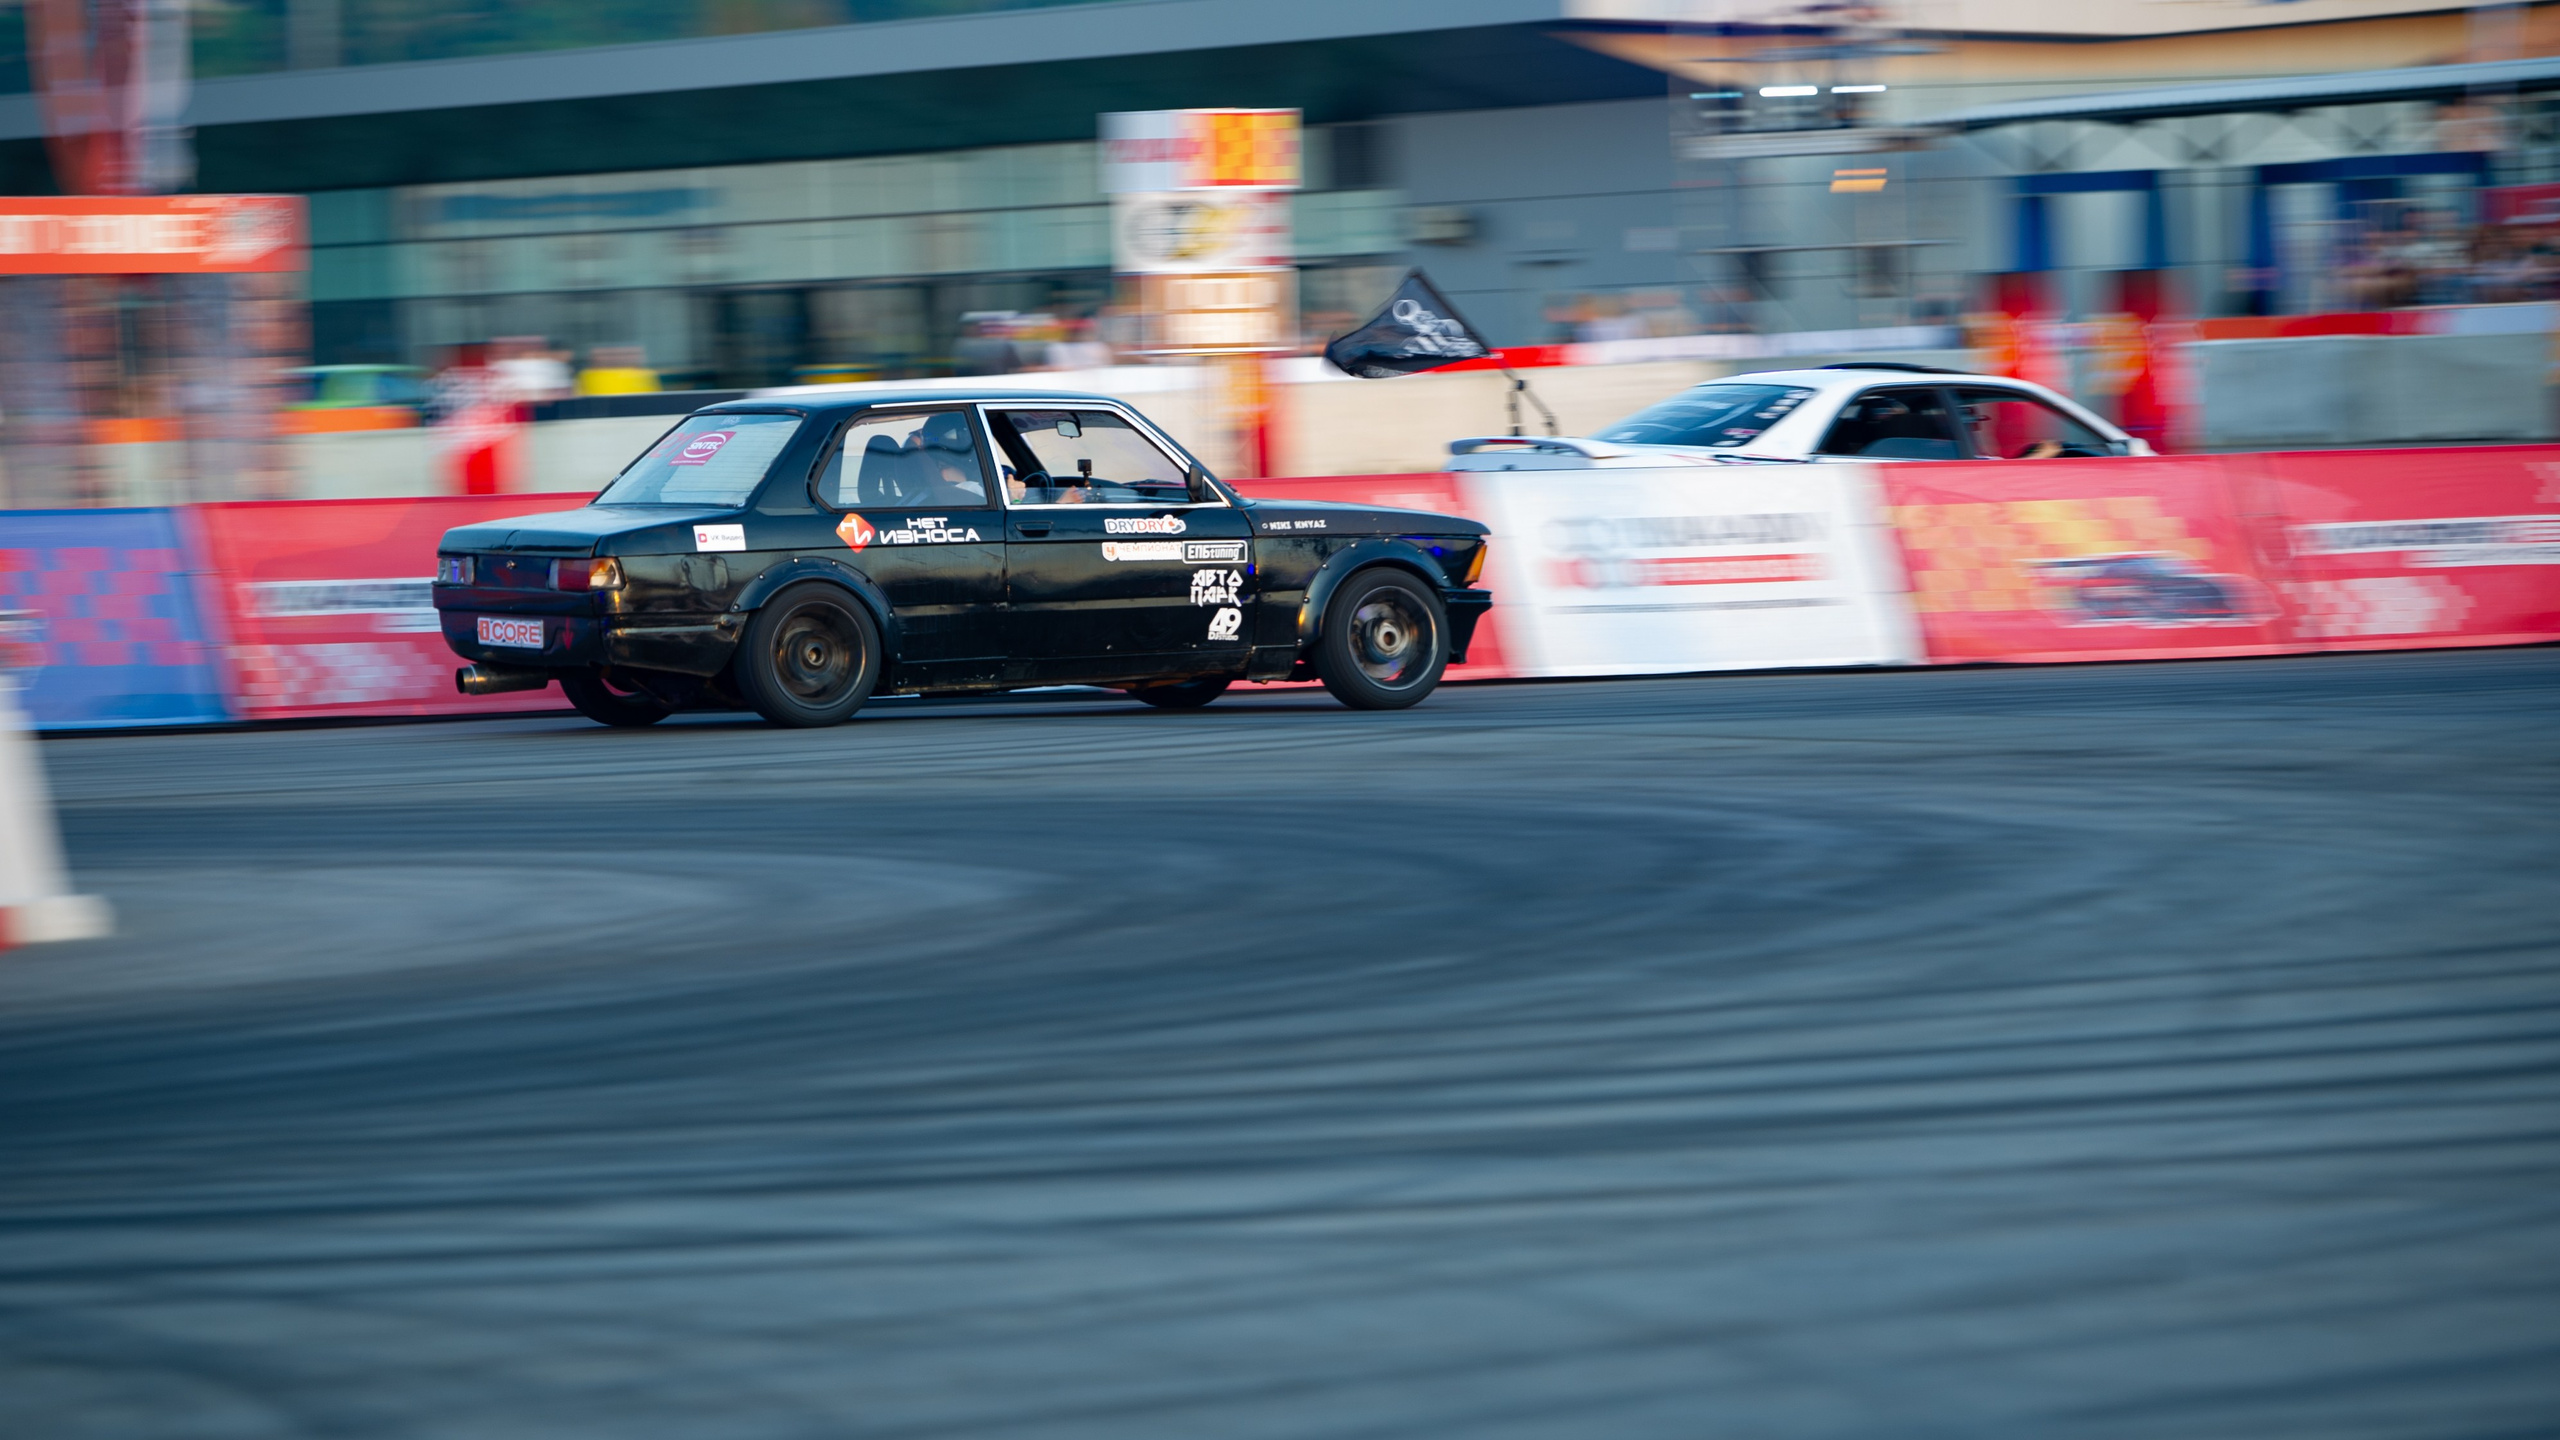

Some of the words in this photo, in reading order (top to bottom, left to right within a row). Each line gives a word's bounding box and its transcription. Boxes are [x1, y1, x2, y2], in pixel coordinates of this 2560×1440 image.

[687, 441, 723, 450] SINTEC
[906, 517, 948, 529] НЕТ
[1106, 520, 1165, 532] DRYDRY
[879, 528, 981, 545] ИЗНОСА
[1119, 543, 1181, 553] ЧЕМПИОНАТ
[1190, 585, 1243, 607] ПАРК
[1209, 607, 1243, 635] 49
